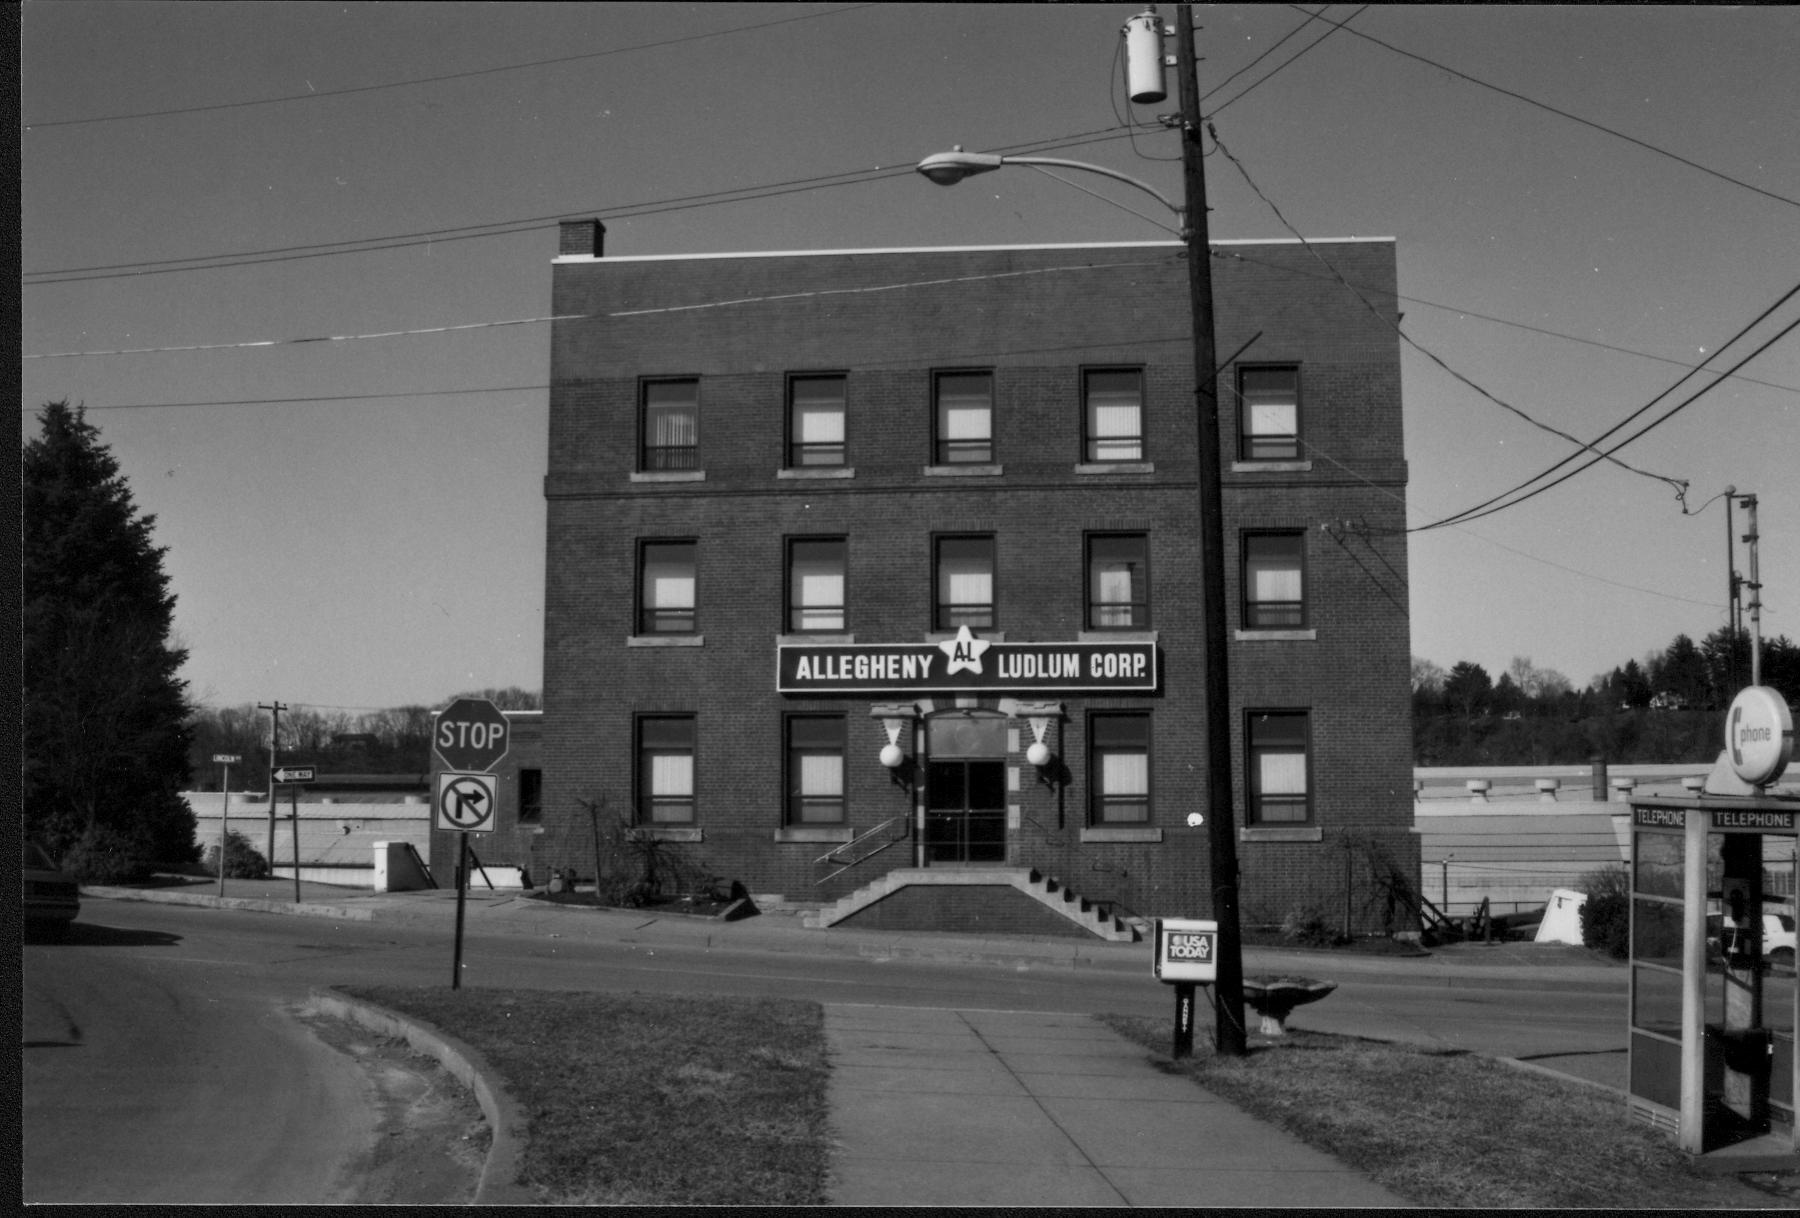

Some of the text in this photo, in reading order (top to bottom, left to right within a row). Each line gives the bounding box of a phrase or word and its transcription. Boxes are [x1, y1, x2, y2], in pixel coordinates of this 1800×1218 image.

[953, 641, 976, 662] AL
[796, 653, 1146, 680] ALLEGHENY LUDLUM CORP.
[440, 721, 504, 749] STOP
[1740, 723, 1771, 747] phone
[284, 770, 312, 779] ONE WAY
[1636, 809, 1685, 826] TELEPHONE
[1716, 812, 1791, 826] TELEPHONE
[1183, 935, 1208, 947] USA
[1169, 945, 1209, 958] TODAY
